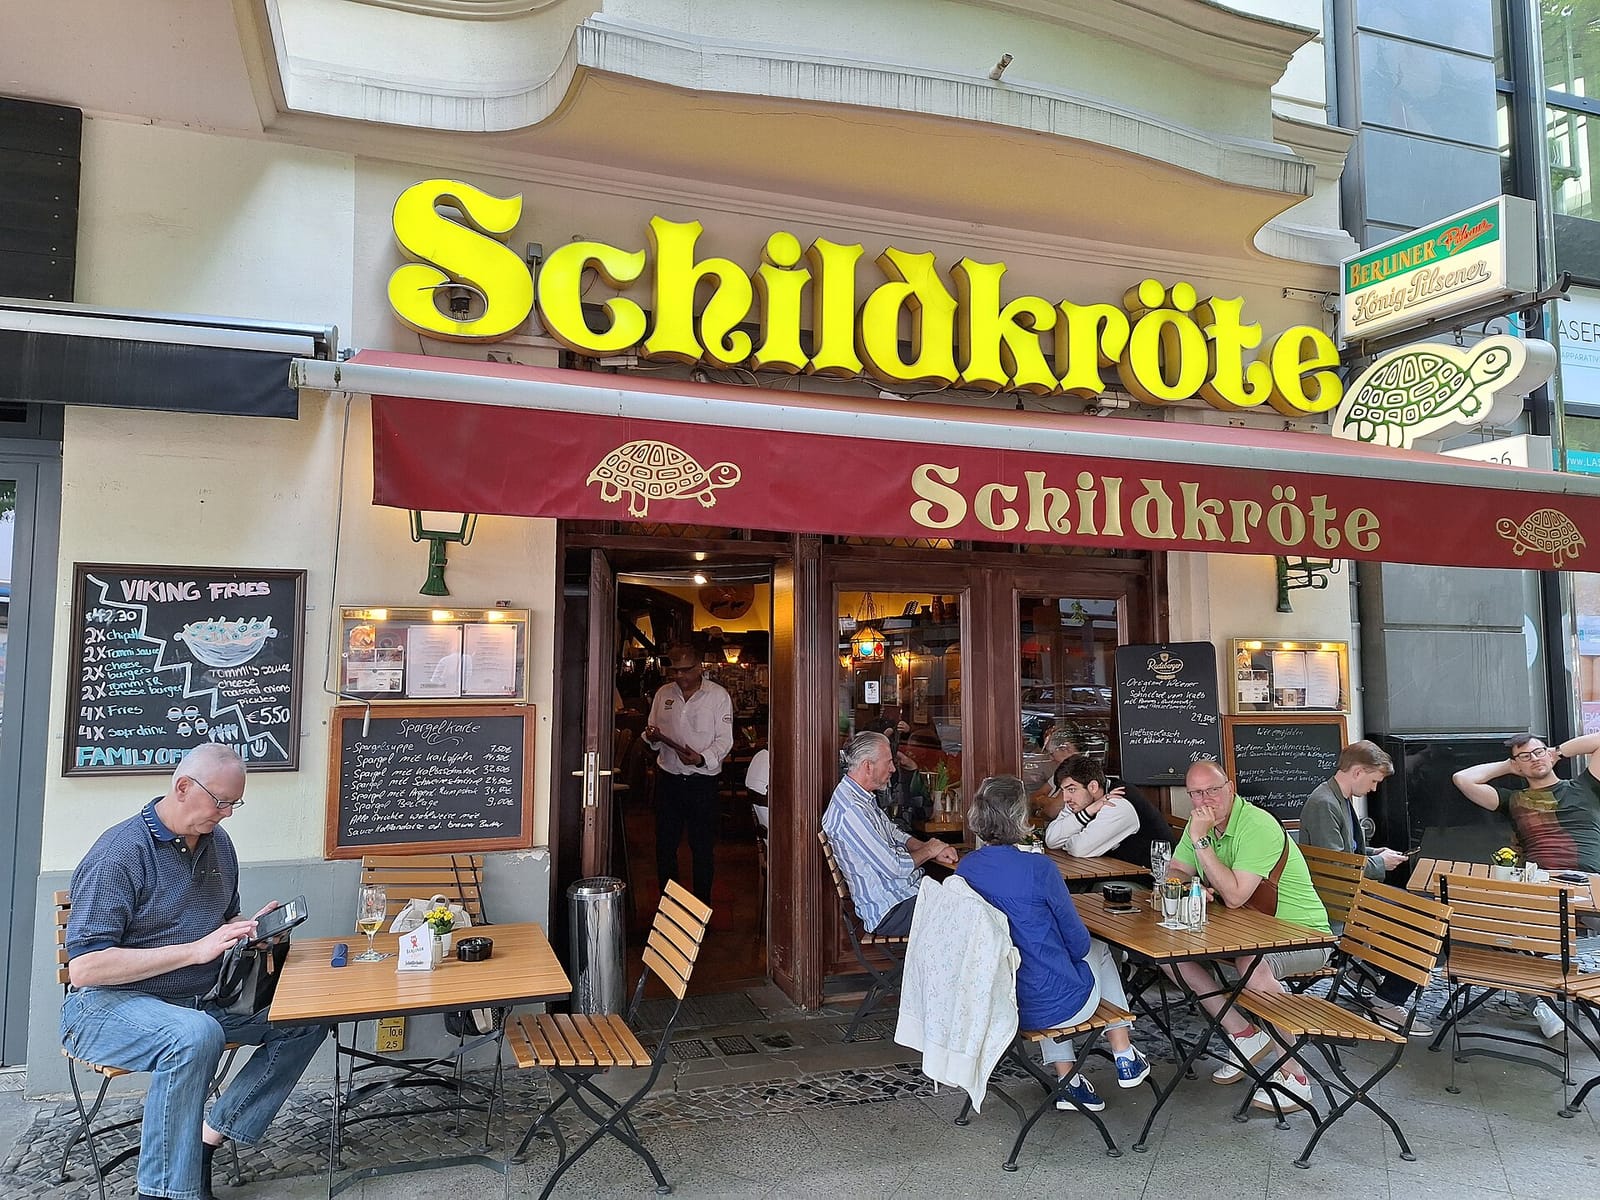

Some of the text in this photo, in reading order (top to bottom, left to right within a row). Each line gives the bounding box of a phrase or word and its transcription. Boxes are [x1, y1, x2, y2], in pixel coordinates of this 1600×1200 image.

[1350, 239, 1437, 288] BERLINER
[387, 178, 1344, 414] Schildkröte
[1352, 260, 1491, 325] König-Pilsener
[1559, 319, 1600, 343] ASER
[909, 463, 1381, 552] Schildkröte
[120, 579, 271, 603] VIKING FRIES
[85, 627, 106, 644] 2X
[84, 646, 106, 663] 2X
[82, 664, 105, 682] 2X
[81, 681, 107, 701] 2X
[237, 696, 276, 707] pickles
[81, 704, 144, 721] 4X Fries
[245, 706, 291, 725] €5.50
[79, 725, 105, 741] 4X
[353, 741, 415, 755] Spargelsuppe
[76, 747, 154, 767] FAMILY
[356, 752, 396, 769] Spargel
[399, 754, 423, 763] mit
[353, 767, 388, 782] Spargel
[391, 769, 414, 777] mit
[351, 779, 384, 793] Spargel
[388, 776, 410, 787] mit
[351, 789, 387, 804] Spargel
[387, 789, 407, 799] mit
[352, 800, 392, 815] Spargel
